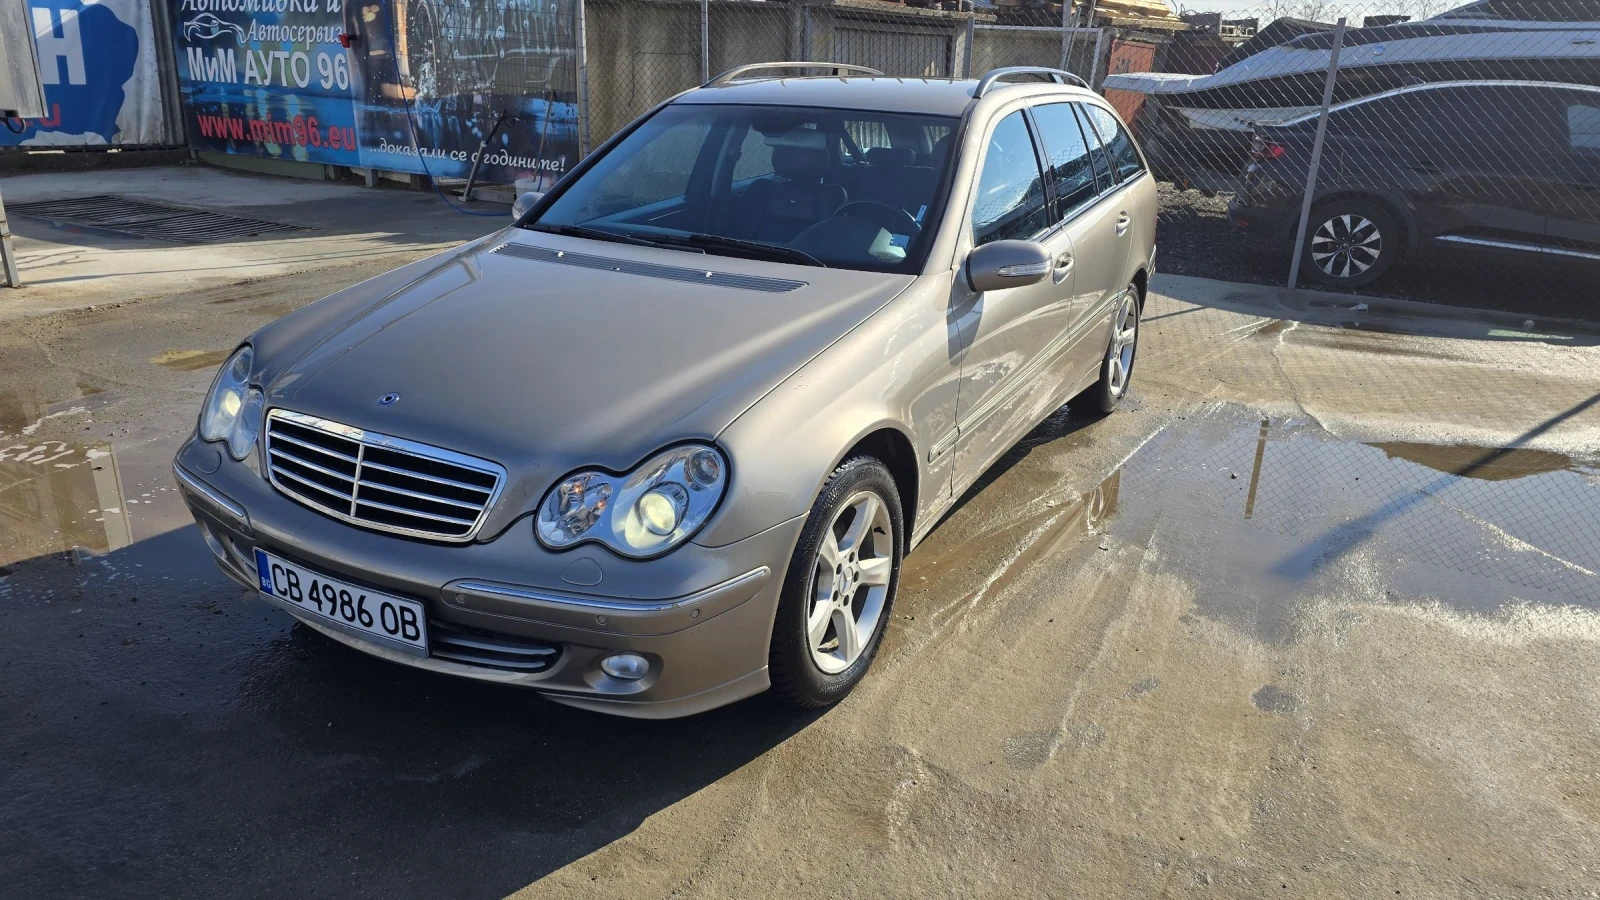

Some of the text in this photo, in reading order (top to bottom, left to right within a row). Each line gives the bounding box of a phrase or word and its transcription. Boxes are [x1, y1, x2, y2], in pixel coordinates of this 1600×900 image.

[247, 18, 343, 51] Автосервиз
[187, 47, 349, 91] МиМ АУТО 96
[197, 112, 357, 151] www.mim96.eu
[450, 149, 467, 161] се
[484, 148, 566, 173] годините!
[261, 576, 272, 589] BG
[272, 563, 421, 642] CB 4986 OB
